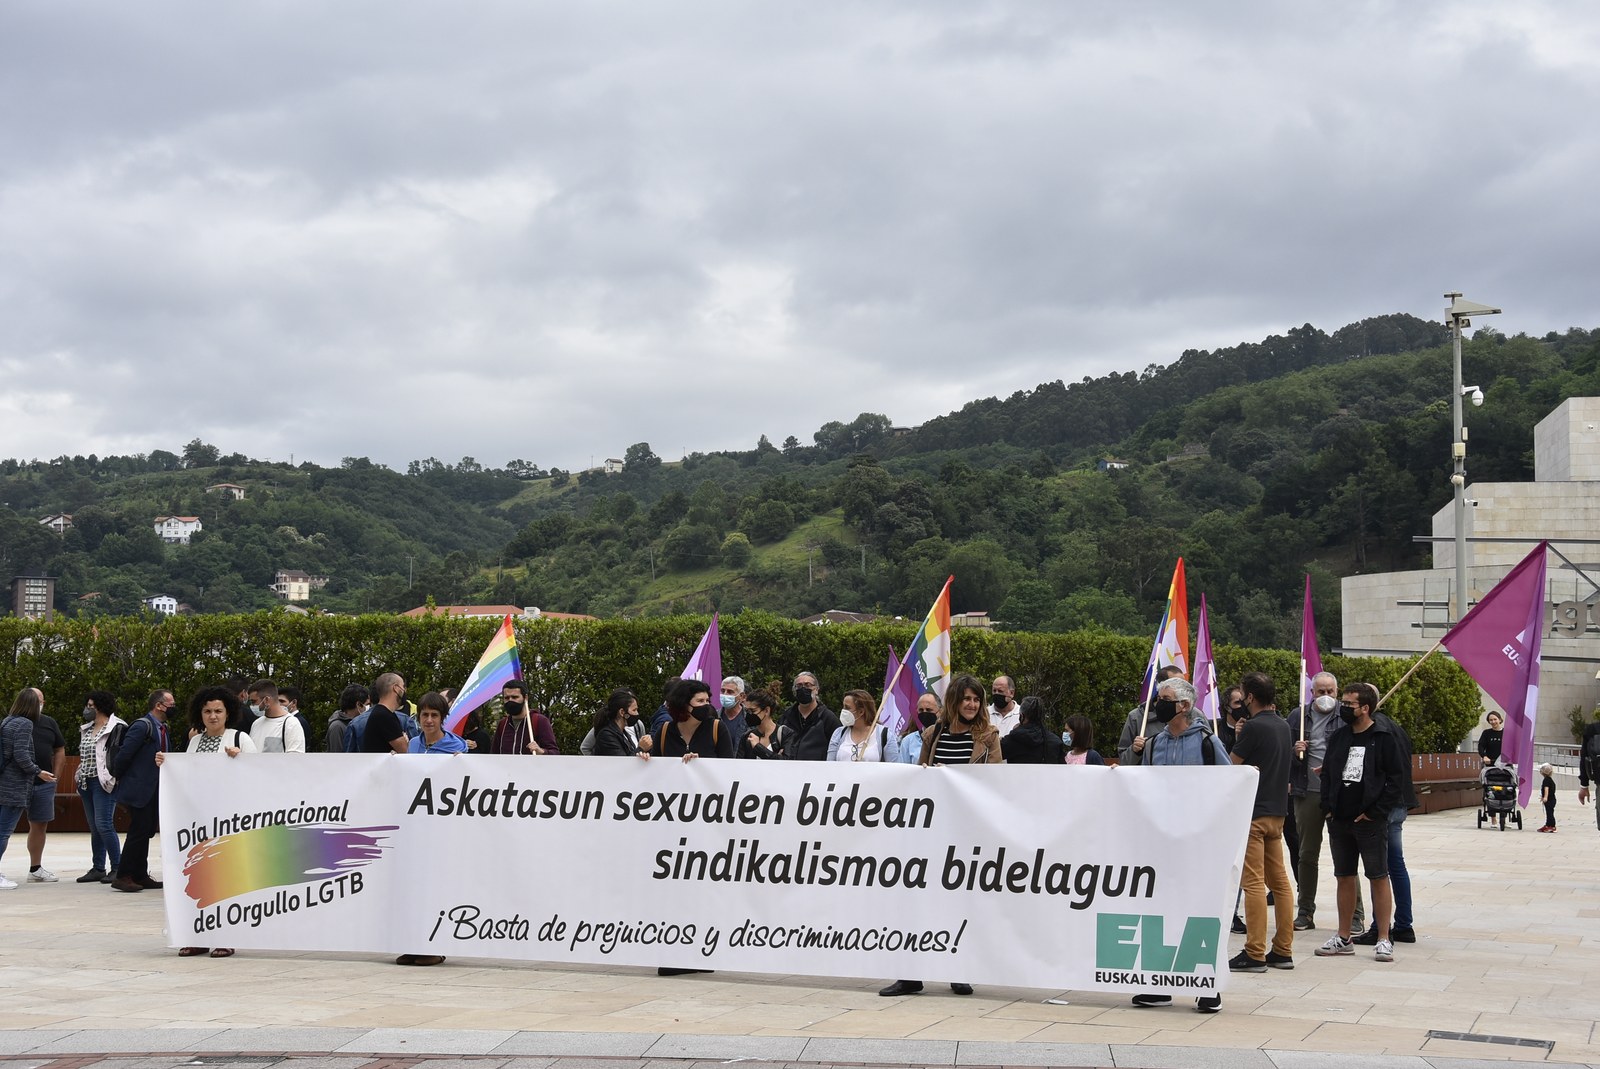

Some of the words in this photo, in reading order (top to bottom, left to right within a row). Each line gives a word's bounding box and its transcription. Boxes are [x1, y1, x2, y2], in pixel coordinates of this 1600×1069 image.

[177, 821, 209, 852] Día
[213, 799, 349, 838] Internacional
[407, 777, 605, 820] Askatasun
[612, 781, 785, 826] sexualen
[796, 782, 935, 829] bidean
[652, 837, 929, 889] sindikalismoa
[941, 845, 1156, 911] bidelagun
[193, 904, 222, 934] del
[226, 890, 301, 928] Orgullo
[306, 871, 364, 909] LGTB
[537, 912, 567, 942] de
[569, 920, 697, 955] prejuicios
[701, 926, 720, 957] y
[728, 917, 968, 952] discriminaciones!
[1096, 912, 1222, 973] ELA
[1095, 971, 1147, 985] EUSKAL
[1151, 974, 1216, 989] SINDIKAT
